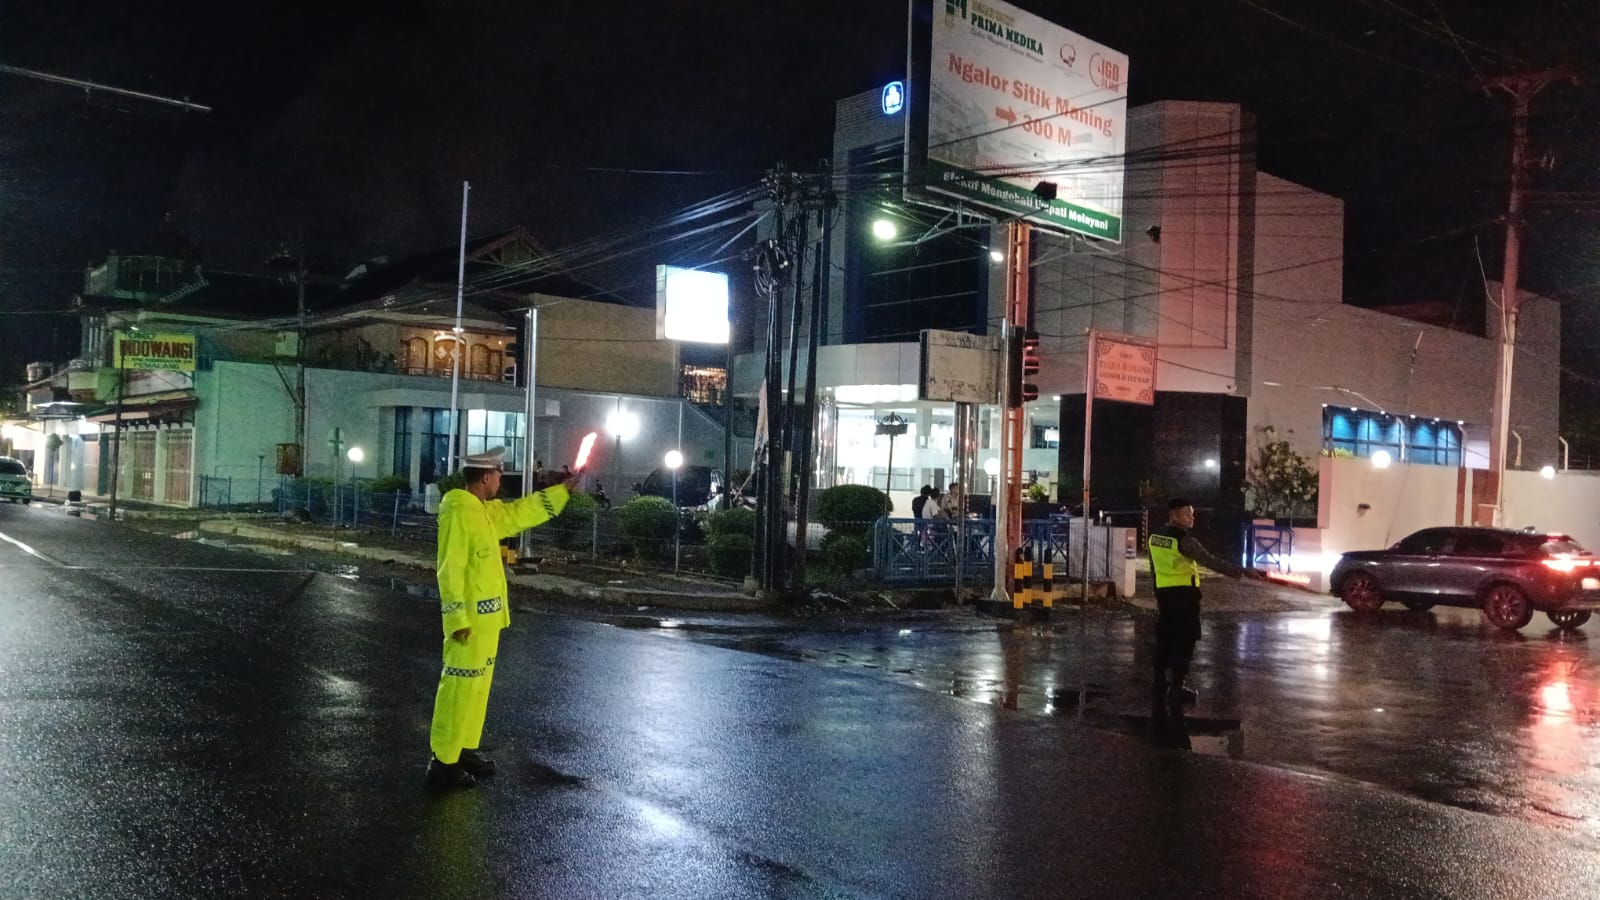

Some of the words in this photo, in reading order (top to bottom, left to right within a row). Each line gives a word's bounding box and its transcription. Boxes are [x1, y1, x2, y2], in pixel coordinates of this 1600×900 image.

[970, 12, 1004, 38] PRIMA
[1006, 27, 1044, 56] MEDIKA
[949, 52, 1009, 93] Ngalor
[1012, 79, 1051, 111] Sitik
[1055, 95, 1113, 137] Maning
[1023, 114, 1053, 140] 300
[1058, 127, 1072, 147] M
[1068, 207, 1109, 231] Melayani
